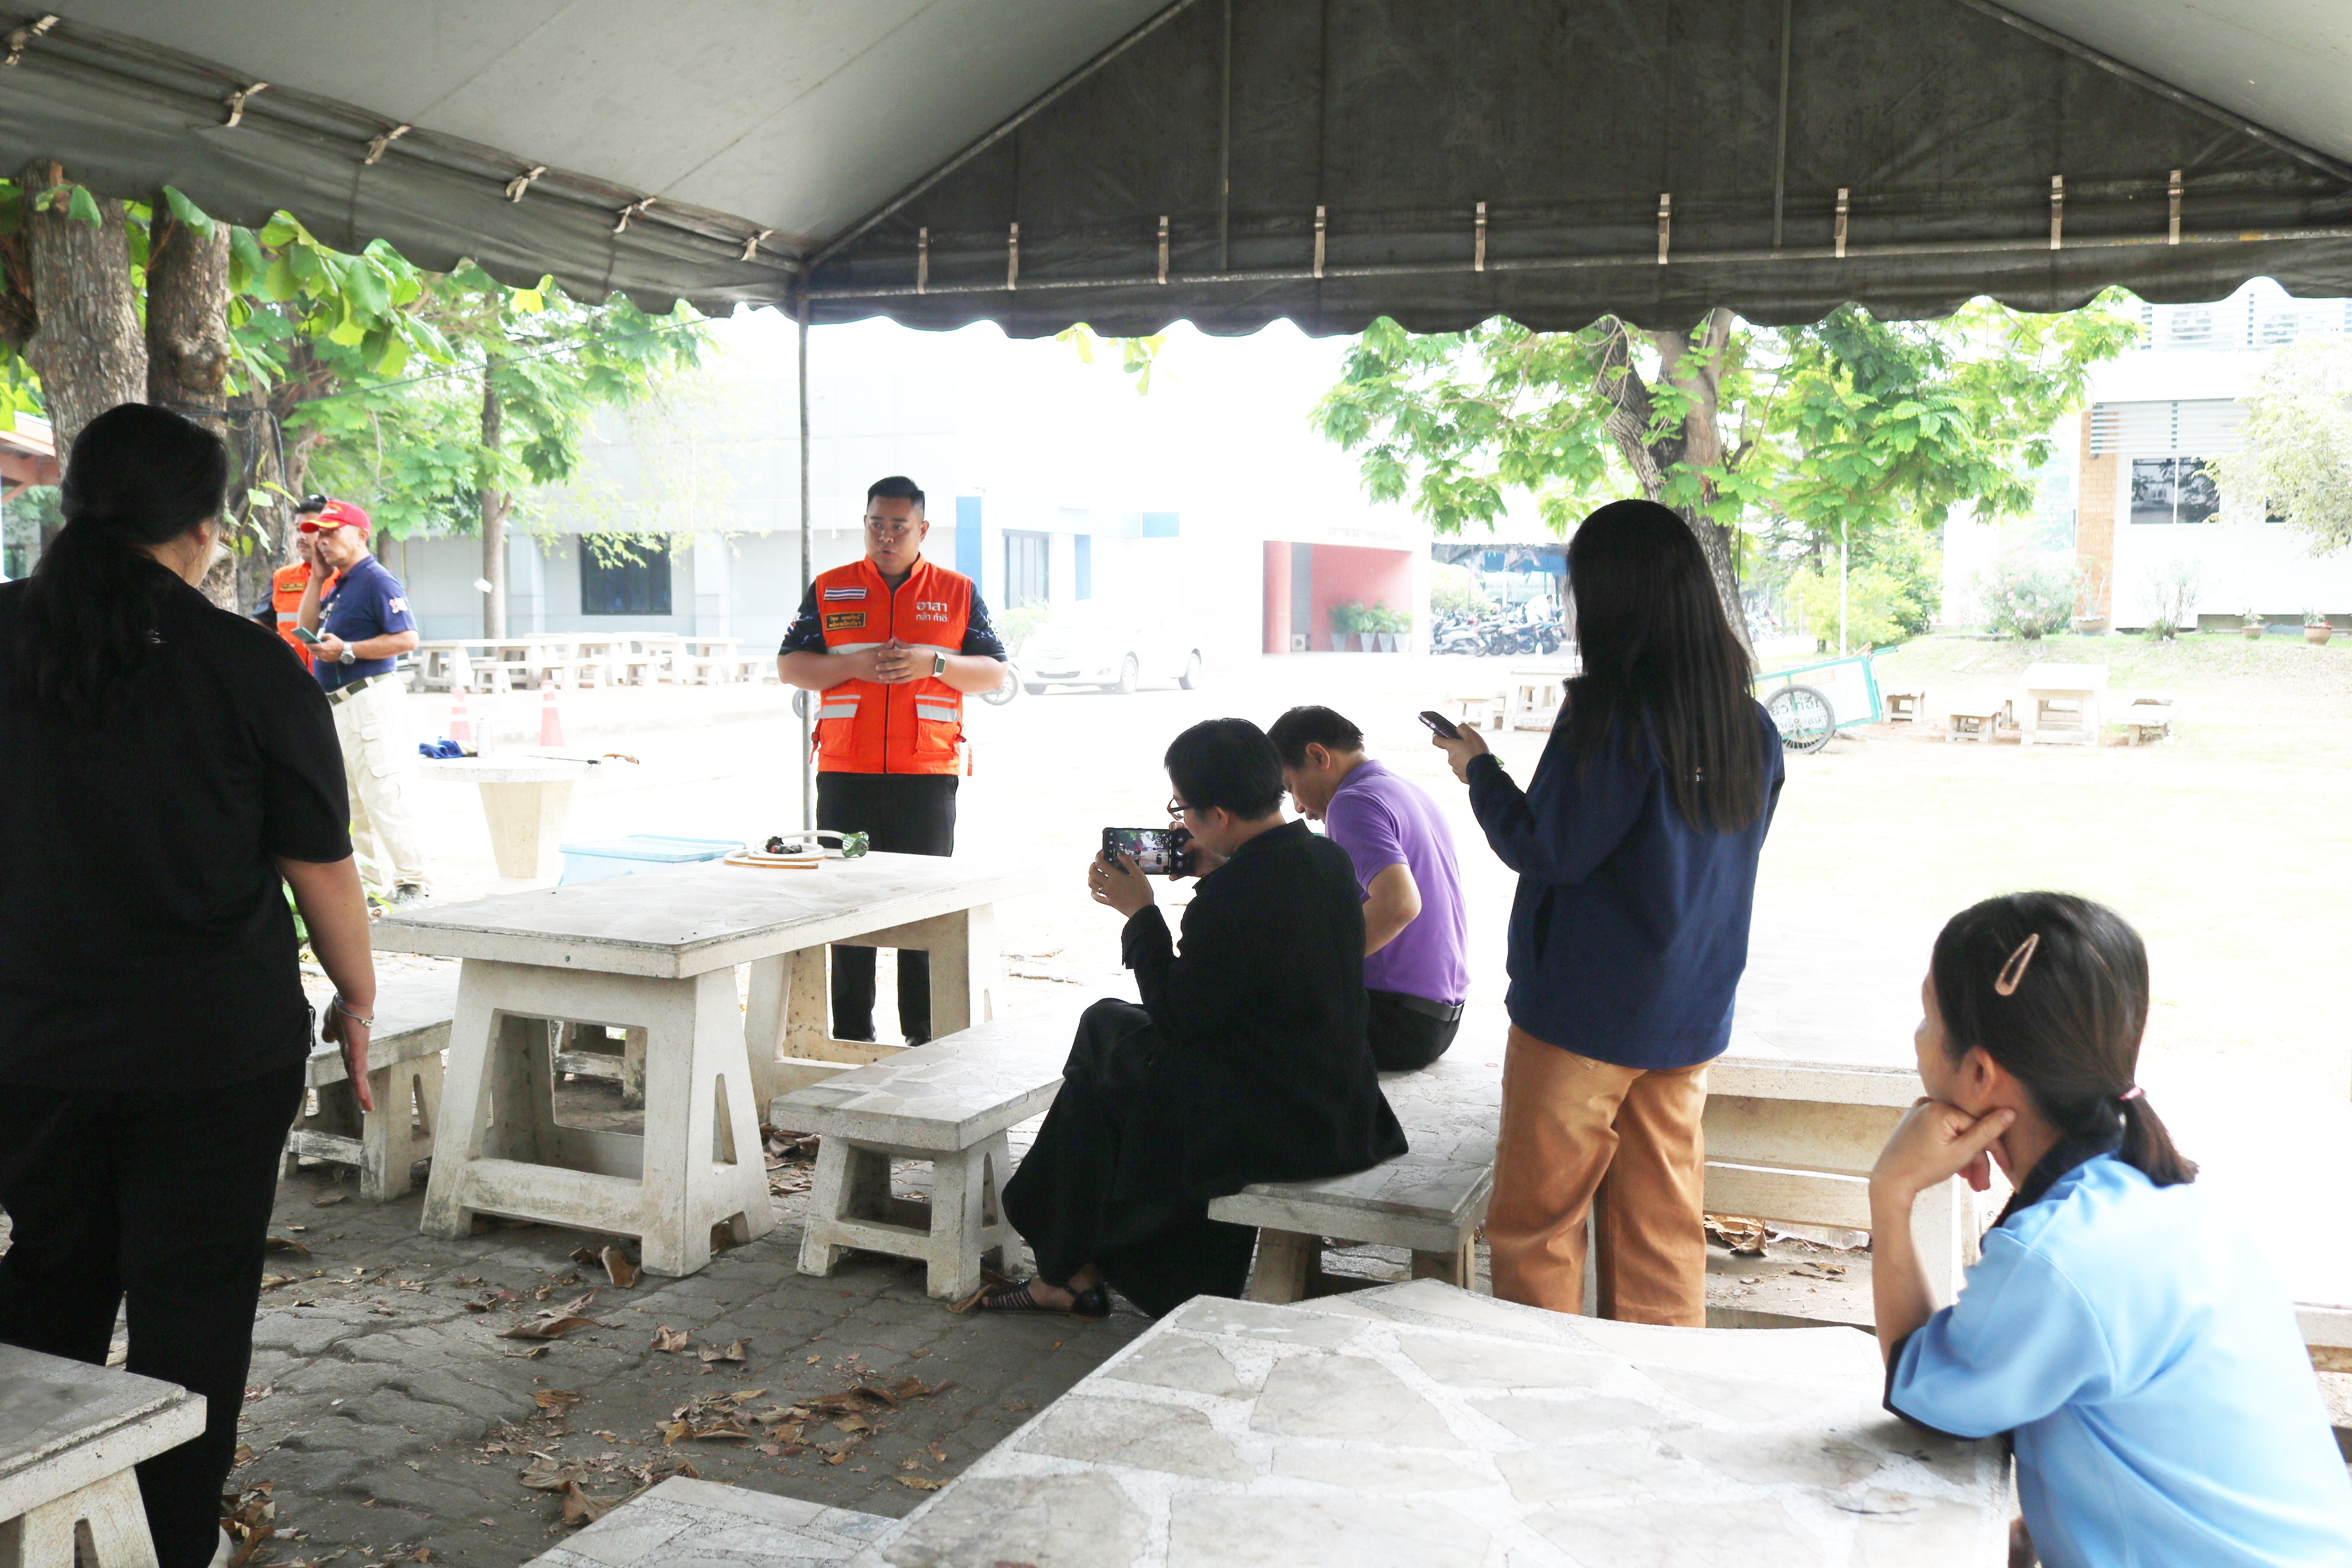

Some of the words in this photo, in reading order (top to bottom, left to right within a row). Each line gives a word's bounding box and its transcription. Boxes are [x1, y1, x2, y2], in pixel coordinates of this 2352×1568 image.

[916, 602, 947, 612] อาสา
[916, 612, 931, 620] กล้า
[933, 613, 948, 622] ทำดี
